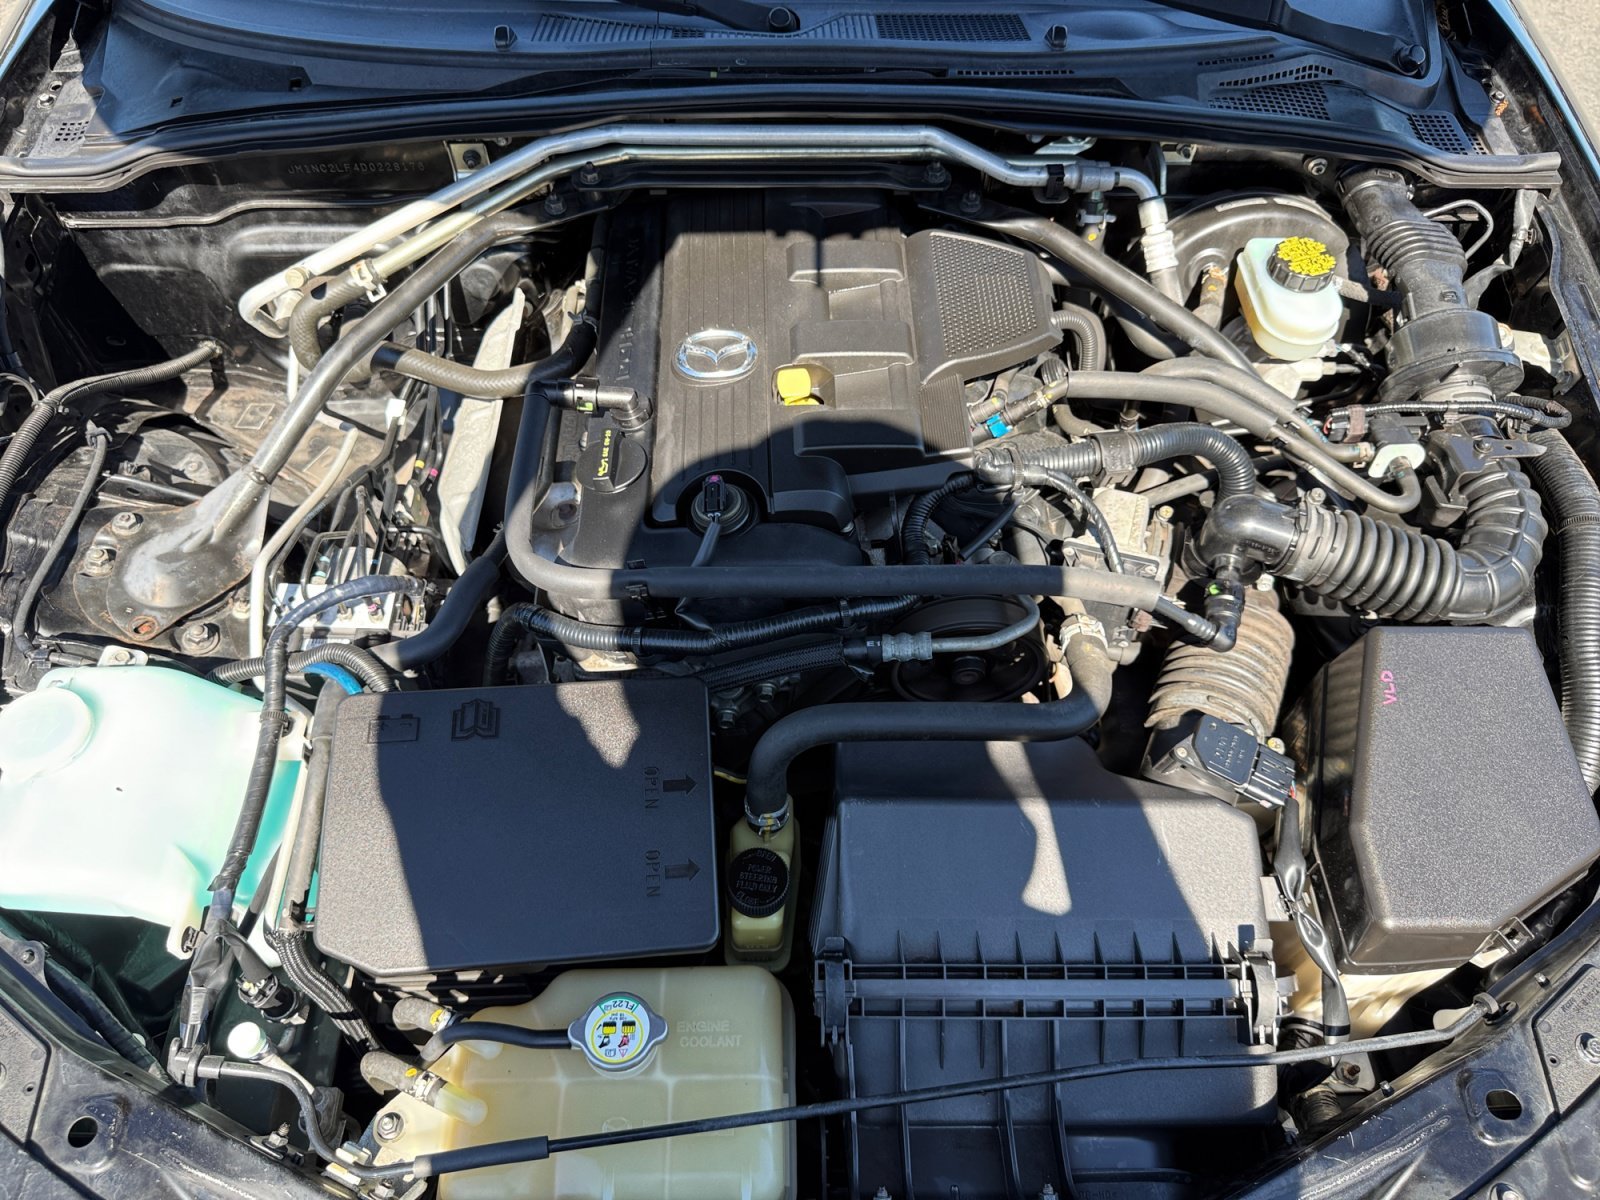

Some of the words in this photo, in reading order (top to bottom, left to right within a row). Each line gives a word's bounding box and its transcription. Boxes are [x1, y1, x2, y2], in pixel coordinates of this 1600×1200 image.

[644, 766, 660, 809] OPEN
[645, 850, 660, 897] OPEN
[612, 1000, 635, 1010] FL22
[676, 1020, 730, 1032] ENGINE
[680, 1034, 742, 1048] COOLANT
